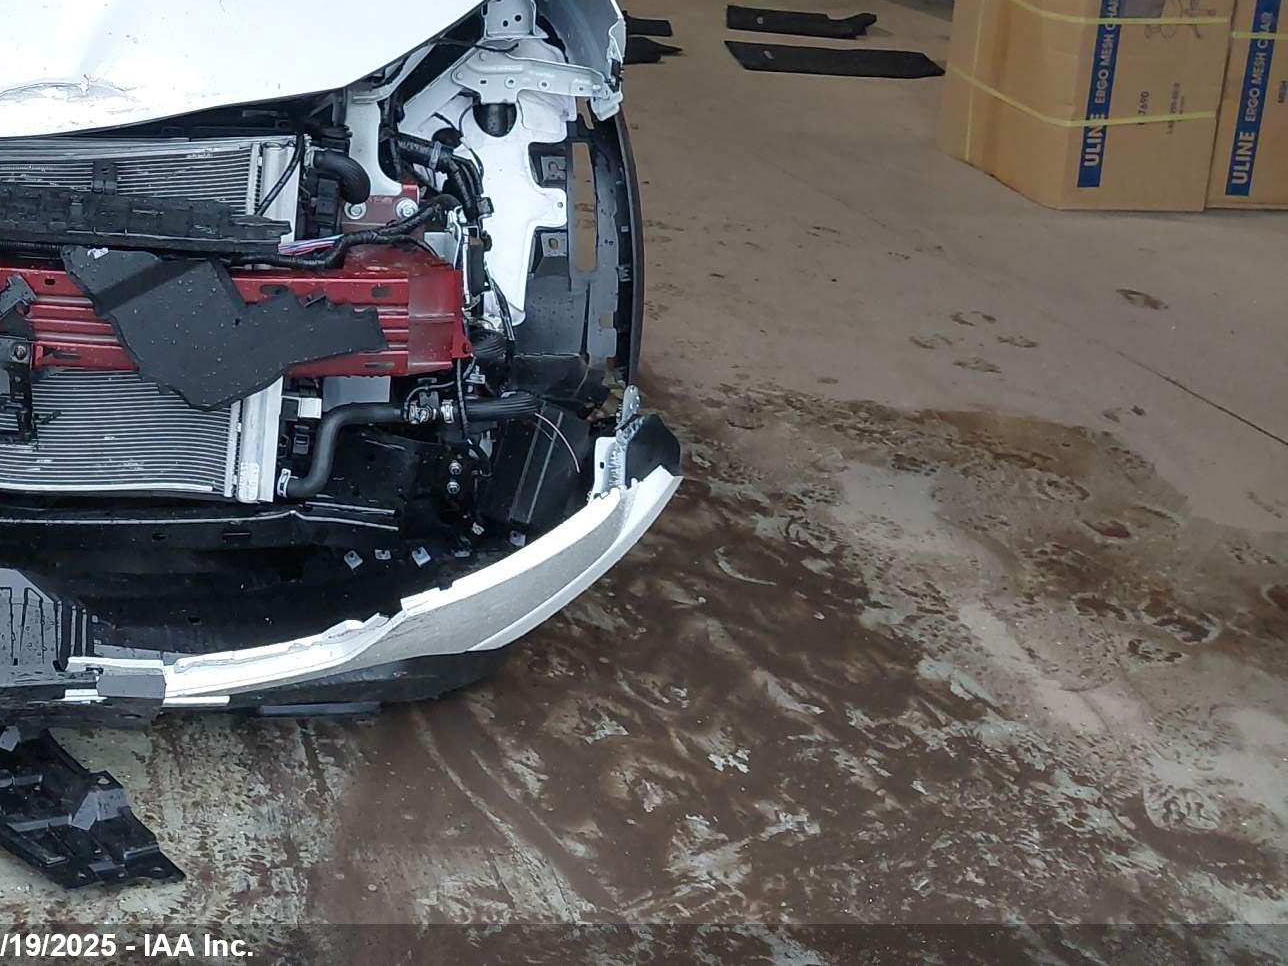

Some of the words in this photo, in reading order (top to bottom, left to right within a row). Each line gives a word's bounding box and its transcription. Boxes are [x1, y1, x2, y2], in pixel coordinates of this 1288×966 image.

[1100, 34, 1114, 66] MESH
[1251, 52, 1267, 84] MESH
[1095, 69, 1109, 104] ERGO
[1245, 87, 1260, 122] ERGO
[1084, 113, 1105, 167] ULINE
[1232, 131, 1255, 184] ULINE
